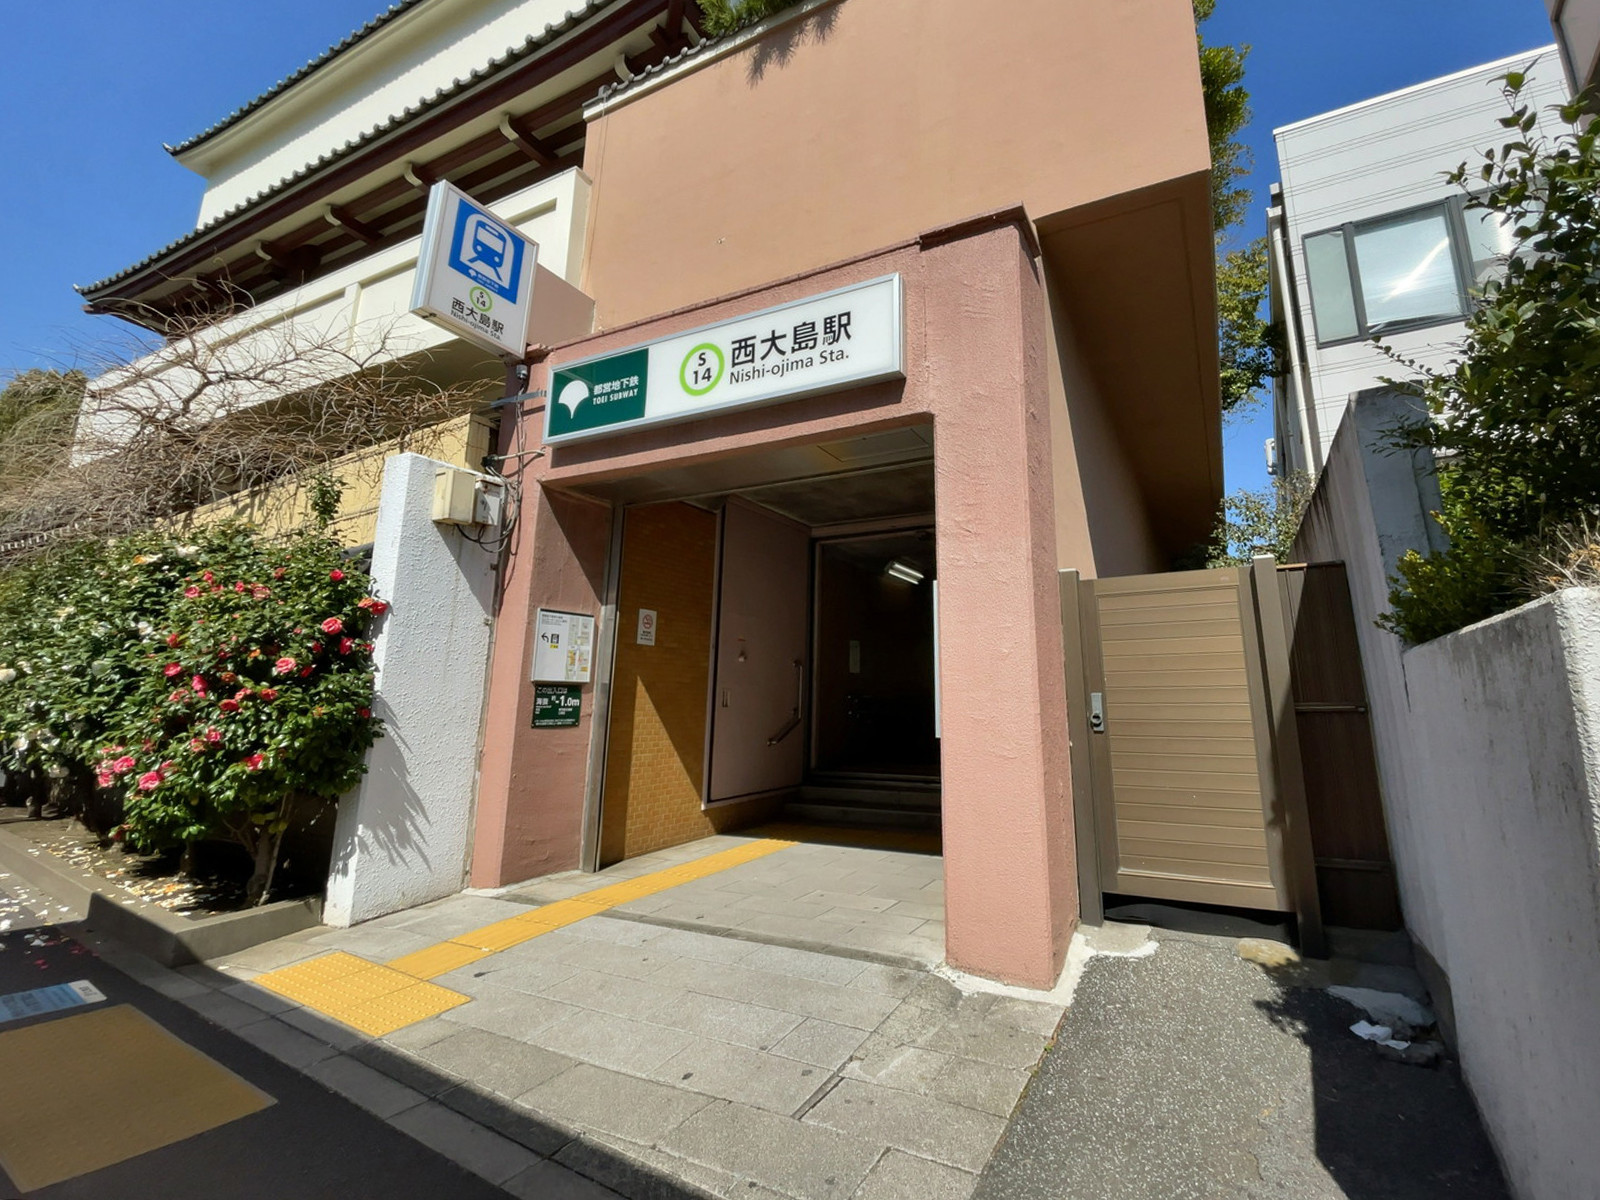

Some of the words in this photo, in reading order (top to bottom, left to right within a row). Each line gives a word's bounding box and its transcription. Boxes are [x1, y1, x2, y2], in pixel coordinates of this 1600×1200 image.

[476, 297, 486, 307] 14
[450, 310, 489, 334] Nishi-ojima
[451, 297, 504, 335] 西大島駅
[731, 311, 852, 368] 西大島駅
[698, 352, 706, 366] S
[729, 357, 813, 385] Nishi-ojima
[819, 348, 849, 365] Sta.
[593, 375, 639, 395] 都営地下鉄
[693, 367, 712, 385] 14
[592, 396, 608, 405] TOEI
[609, 388, 639, 402] SUBWAY
